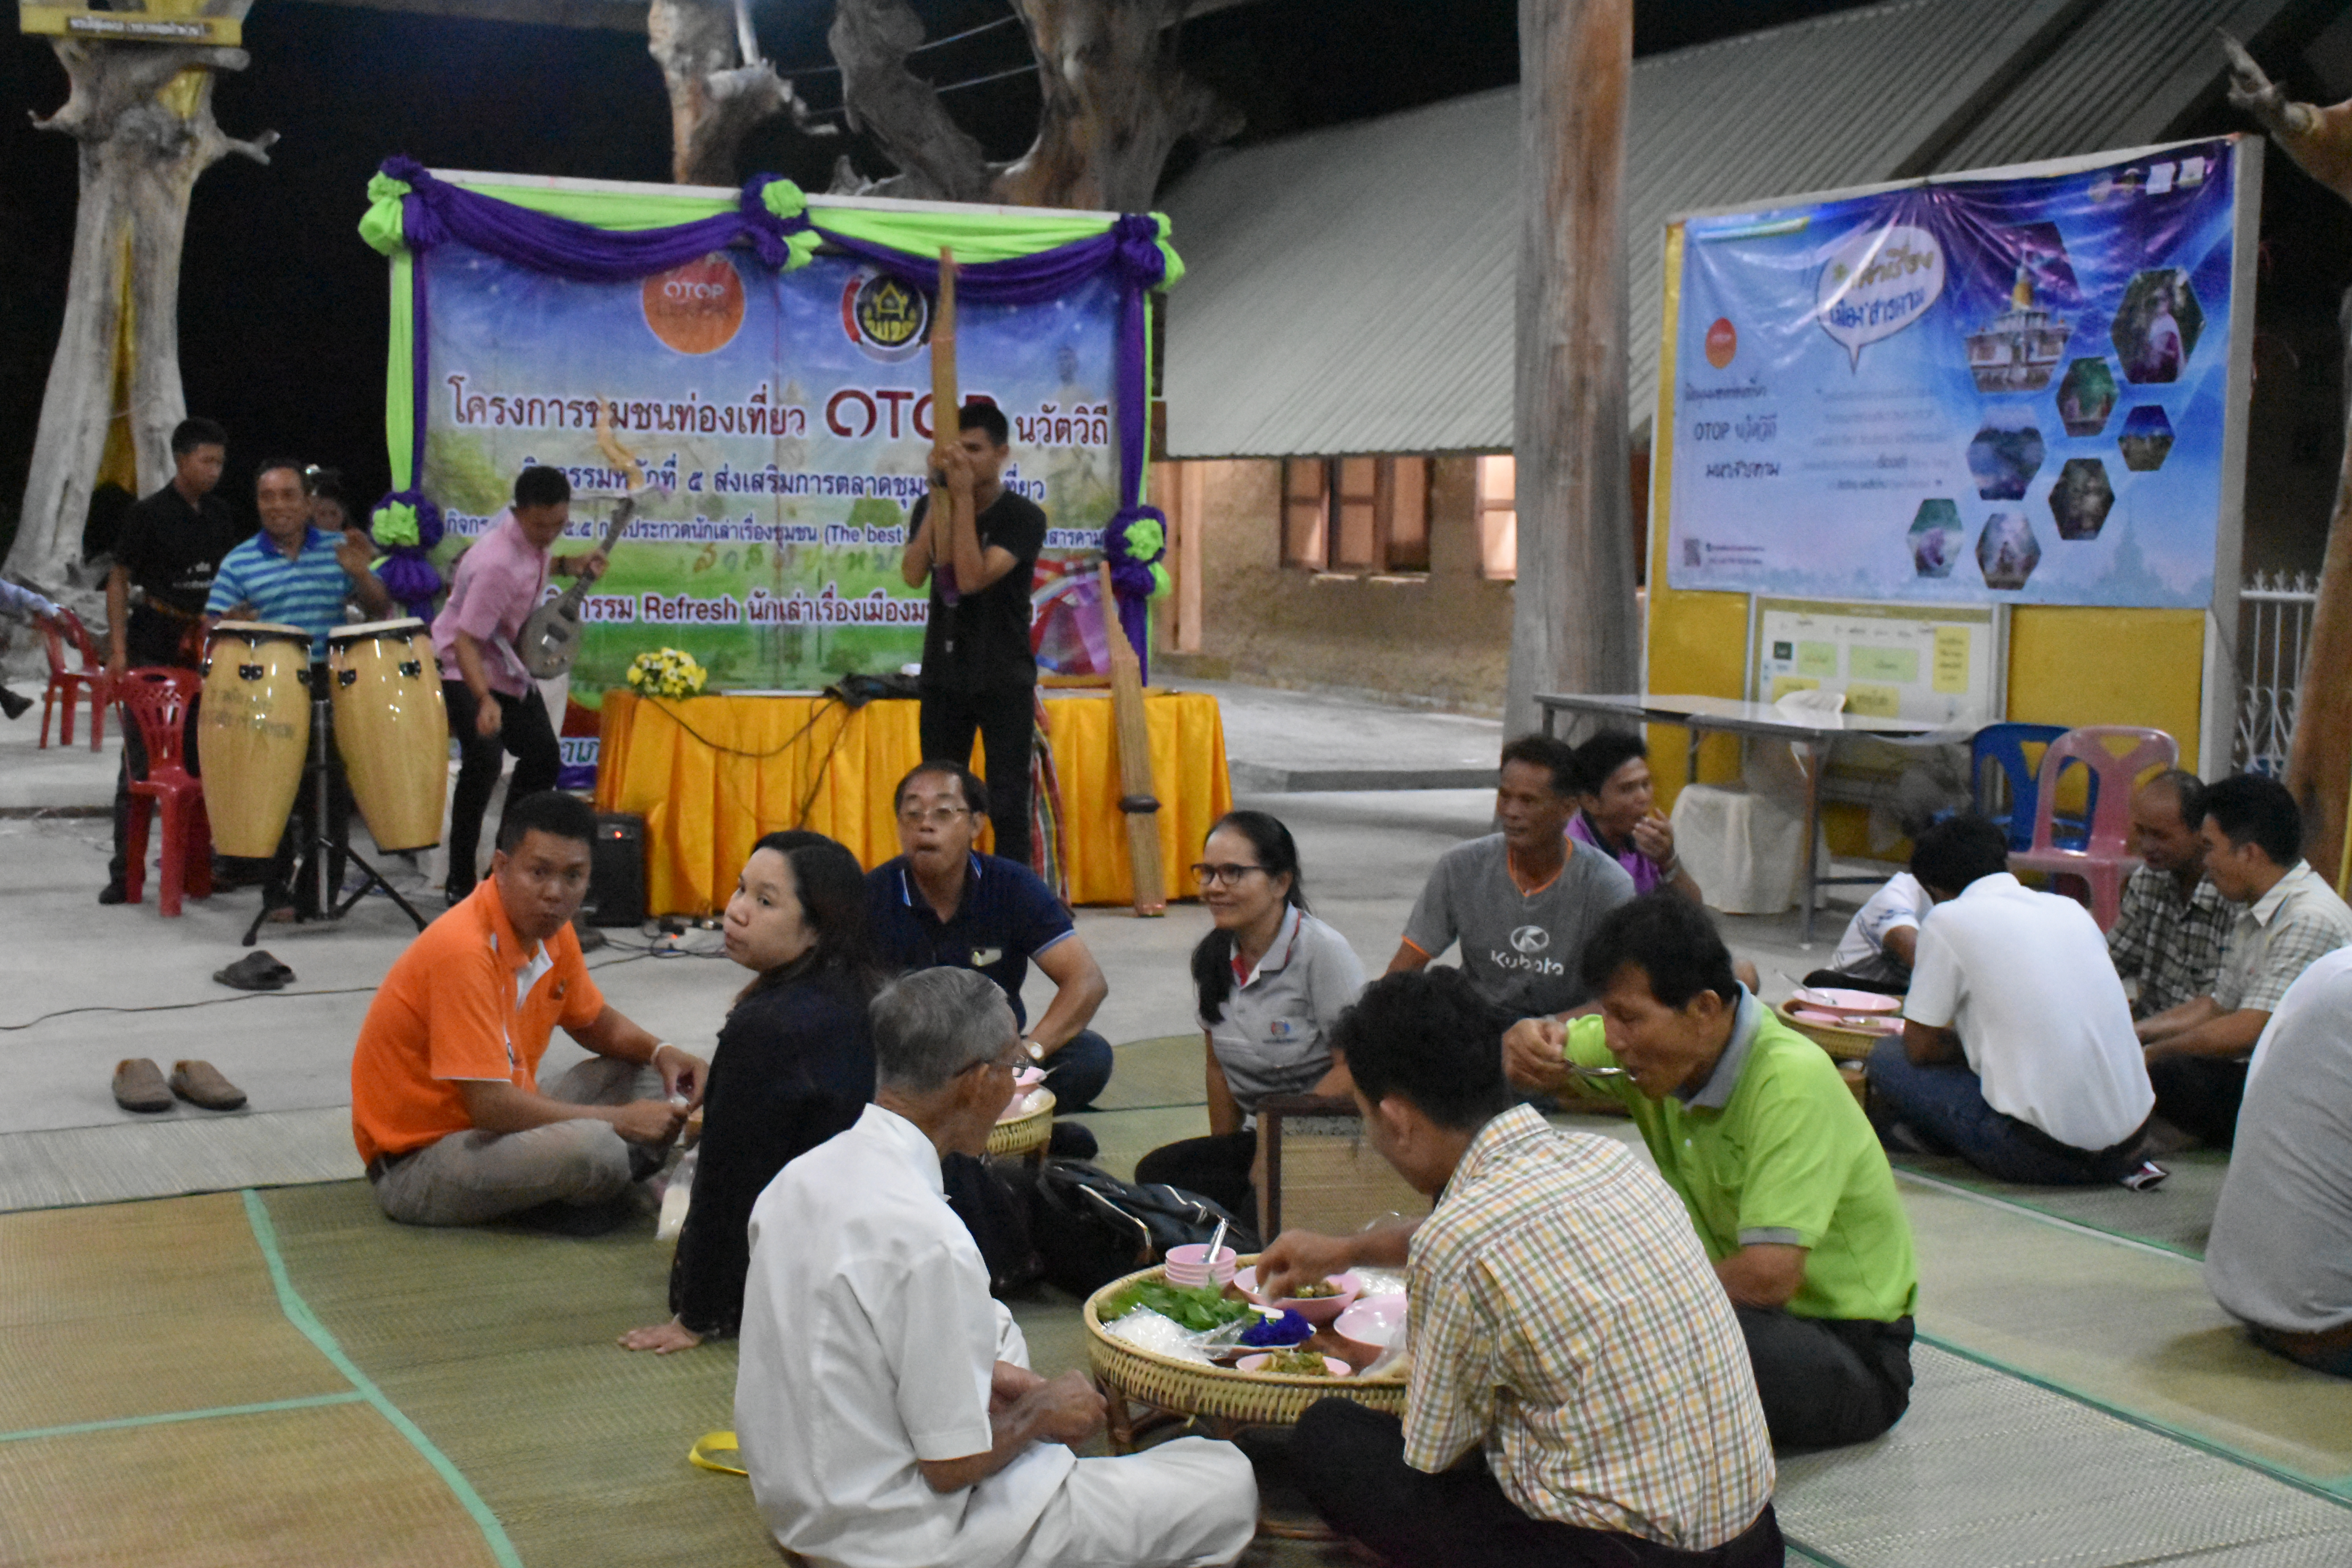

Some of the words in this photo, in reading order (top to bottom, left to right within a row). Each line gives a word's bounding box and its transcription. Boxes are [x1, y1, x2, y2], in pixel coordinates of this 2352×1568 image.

[664, 281, 725, 299] OTOP
[1014, 404, 1109, 445] นวัตวิถี
[825, 524, 860, 546] (The
[867, 524, 902, 543] best
[645, 596, 738, 620] Refresh
[1491, 949, 1564, 975] Kubota
